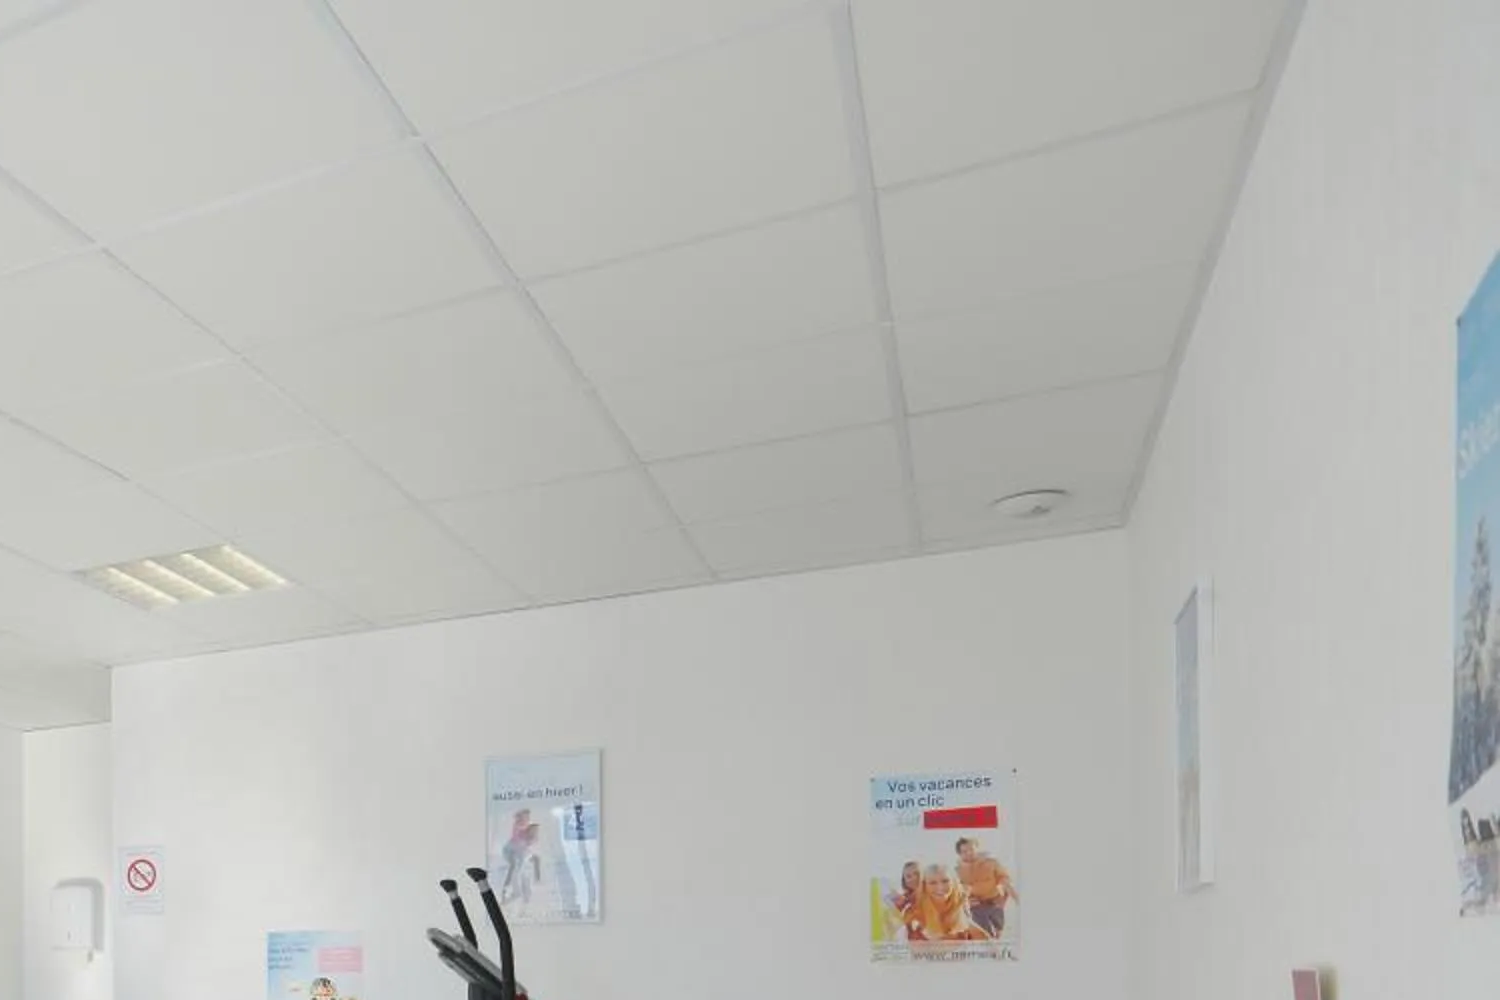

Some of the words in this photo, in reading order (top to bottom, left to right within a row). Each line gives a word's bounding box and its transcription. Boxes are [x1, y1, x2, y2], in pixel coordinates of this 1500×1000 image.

[887, 780, 916, 792] Vos
[920, 776, 993, 791] vacances
[875, 799, 893, 810] en
[897, 797, 915, 809] un
[917, 794, 945, 807] clic
